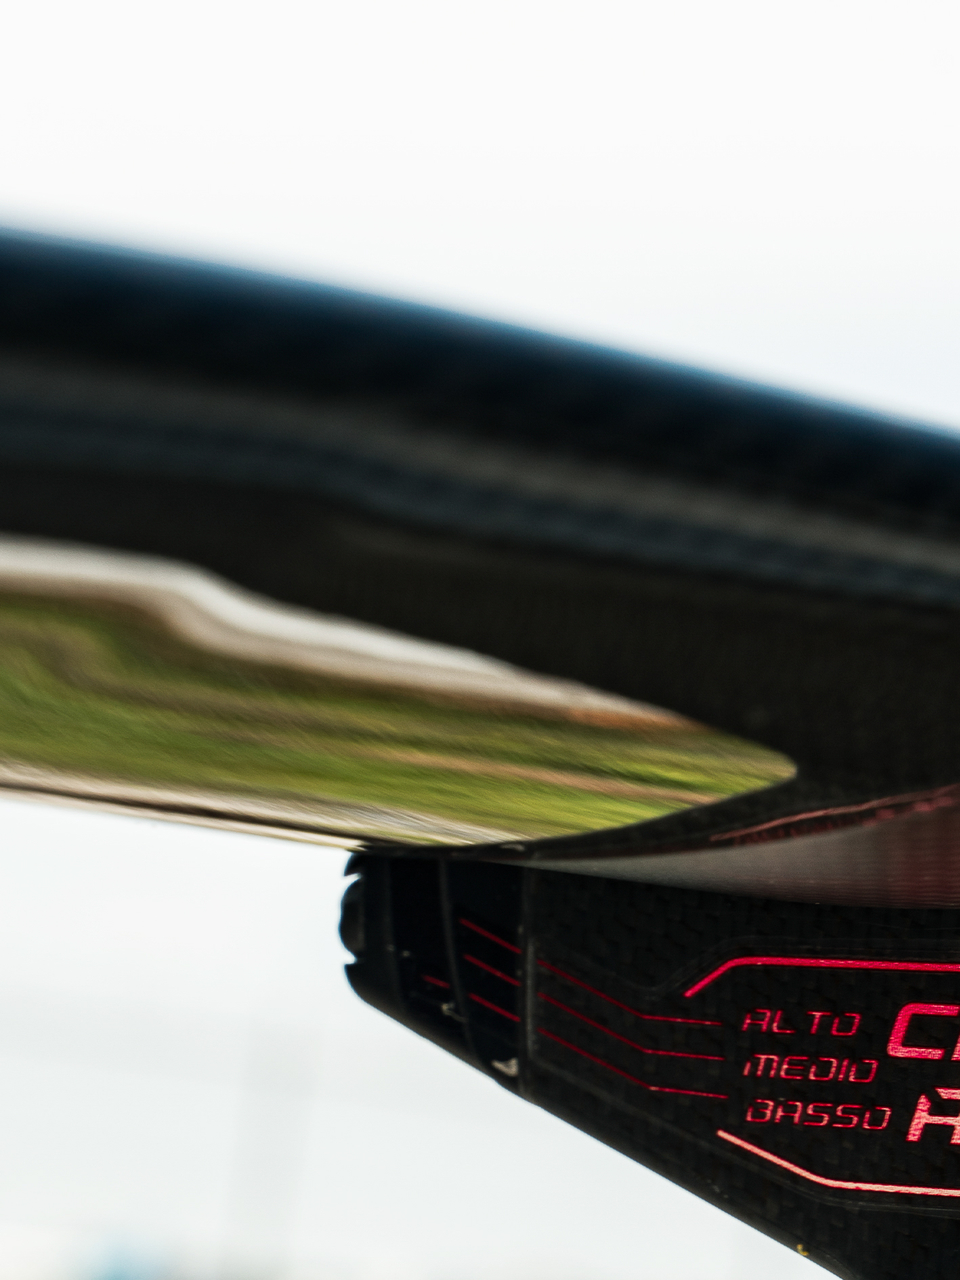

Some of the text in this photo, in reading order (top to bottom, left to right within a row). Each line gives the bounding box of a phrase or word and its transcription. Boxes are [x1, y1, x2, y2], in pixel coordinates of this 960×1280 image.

[743, 1009, 861, 1036] ALTO
[743, 1055, 879, 1083] MEDIO
[746, 1100, 892, 1130] BASSO
